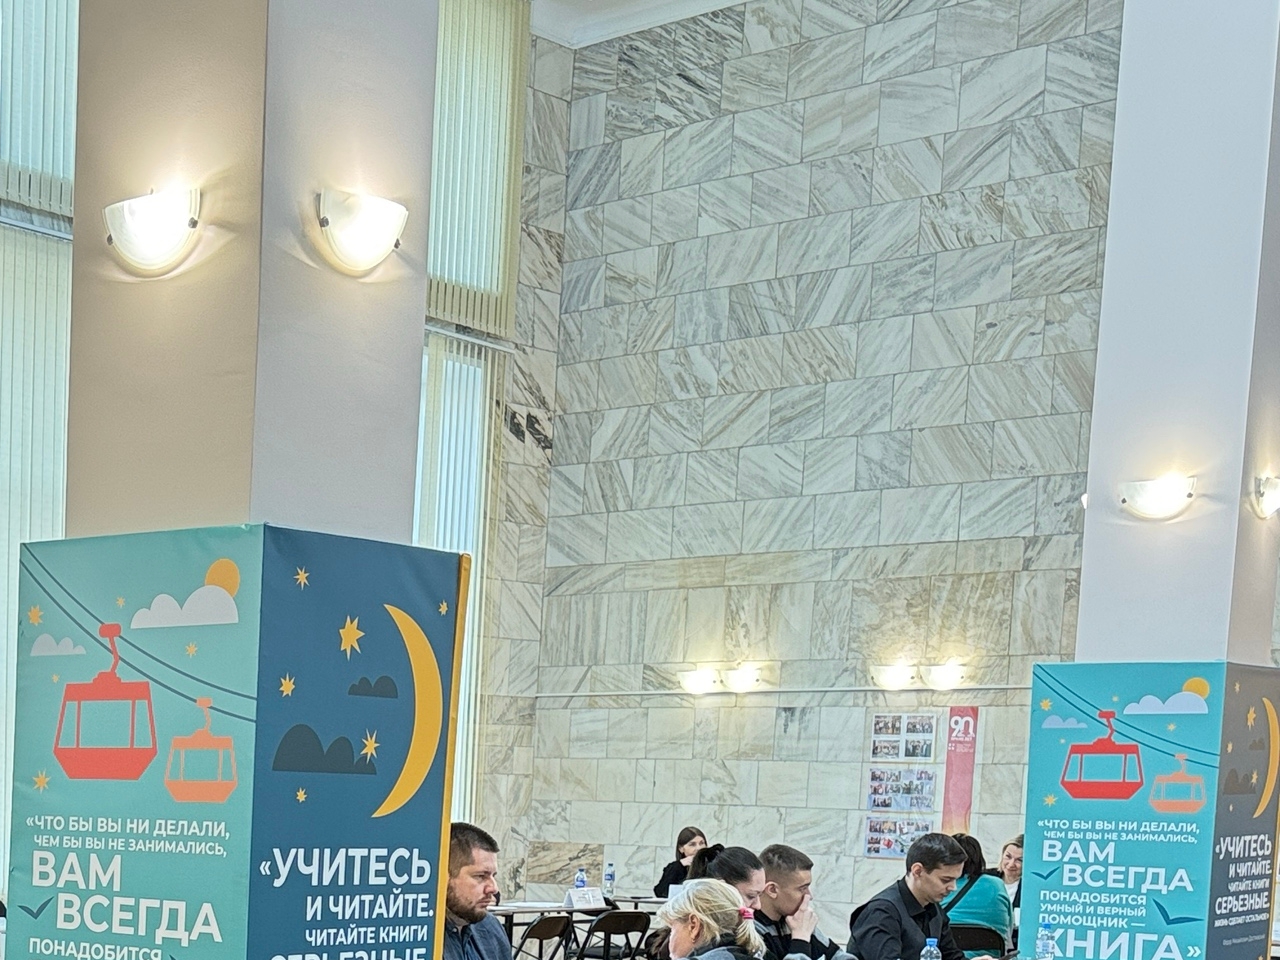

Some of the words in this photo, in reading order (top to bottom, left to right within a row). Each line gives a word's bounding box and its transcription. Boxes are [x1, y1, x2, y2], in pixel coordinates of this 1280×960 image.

[26, 815, 65, 830] «ЧТО
[69, 816, 92, 831] БЫ
[97, 818, 121, 833] ВЫ
[127, 819, 149, 834] НИ
[153, 819, 230, 840] ДЕЛАЛИ,
[1038, 819, 1069, 829] «ЧТО
[1073, 820, 1091, 829] БЫ
[1096, 820, 1114, 830] ВЫ
[1119, 821, 1137, 831] НИ
[1140, 822, 1199, 834] ДЕЛАЛИ,
[1068, 831, 1083, 839] БЫ
[1086, 832, 1101, 840] ВЫ
[1120, 833, 1197, 844] ЗАНИМАЛИСЬ,
[34, 835, 59, 847] ЧЕМ
[63, 836, 81, 848] БЫ
[86, 837, 104, 849] ВЫ
[109, 838, 125, 850] НЕ
[128, 839, 227, 857] ЗАНИМАЛИСЬ,
[1042, 840, 1115, 863] ВАМ
[32, 850, 121, 891] ВАМ
[260, 847, 431, 888] «УЧИТЕСЬ
[1061, 863, 1194, 895] ВСЕГДА
[1229, 863, 1235, 878] И
[306, 896, 322, 922] И
[328, 888, 434, 919] ЧИТАЙТЕ.
[1040, 890, 1146, 905] ПОНАДОБИТСЯ
[56, 893, 223, 946] ВСЕГДА
[1039, 913, 1128, 928] ПОМОЩНИК
[1040, 903, 1083, 913] УМНЫЙ
[1086, 905, 1094, 914] И
[1097, 906, 1146, 917] ВЕРНЫЙ
[305, 922, 376, 947] ЧИТАЙТЕ
[379, 924, 428, 944] КНИГИ
